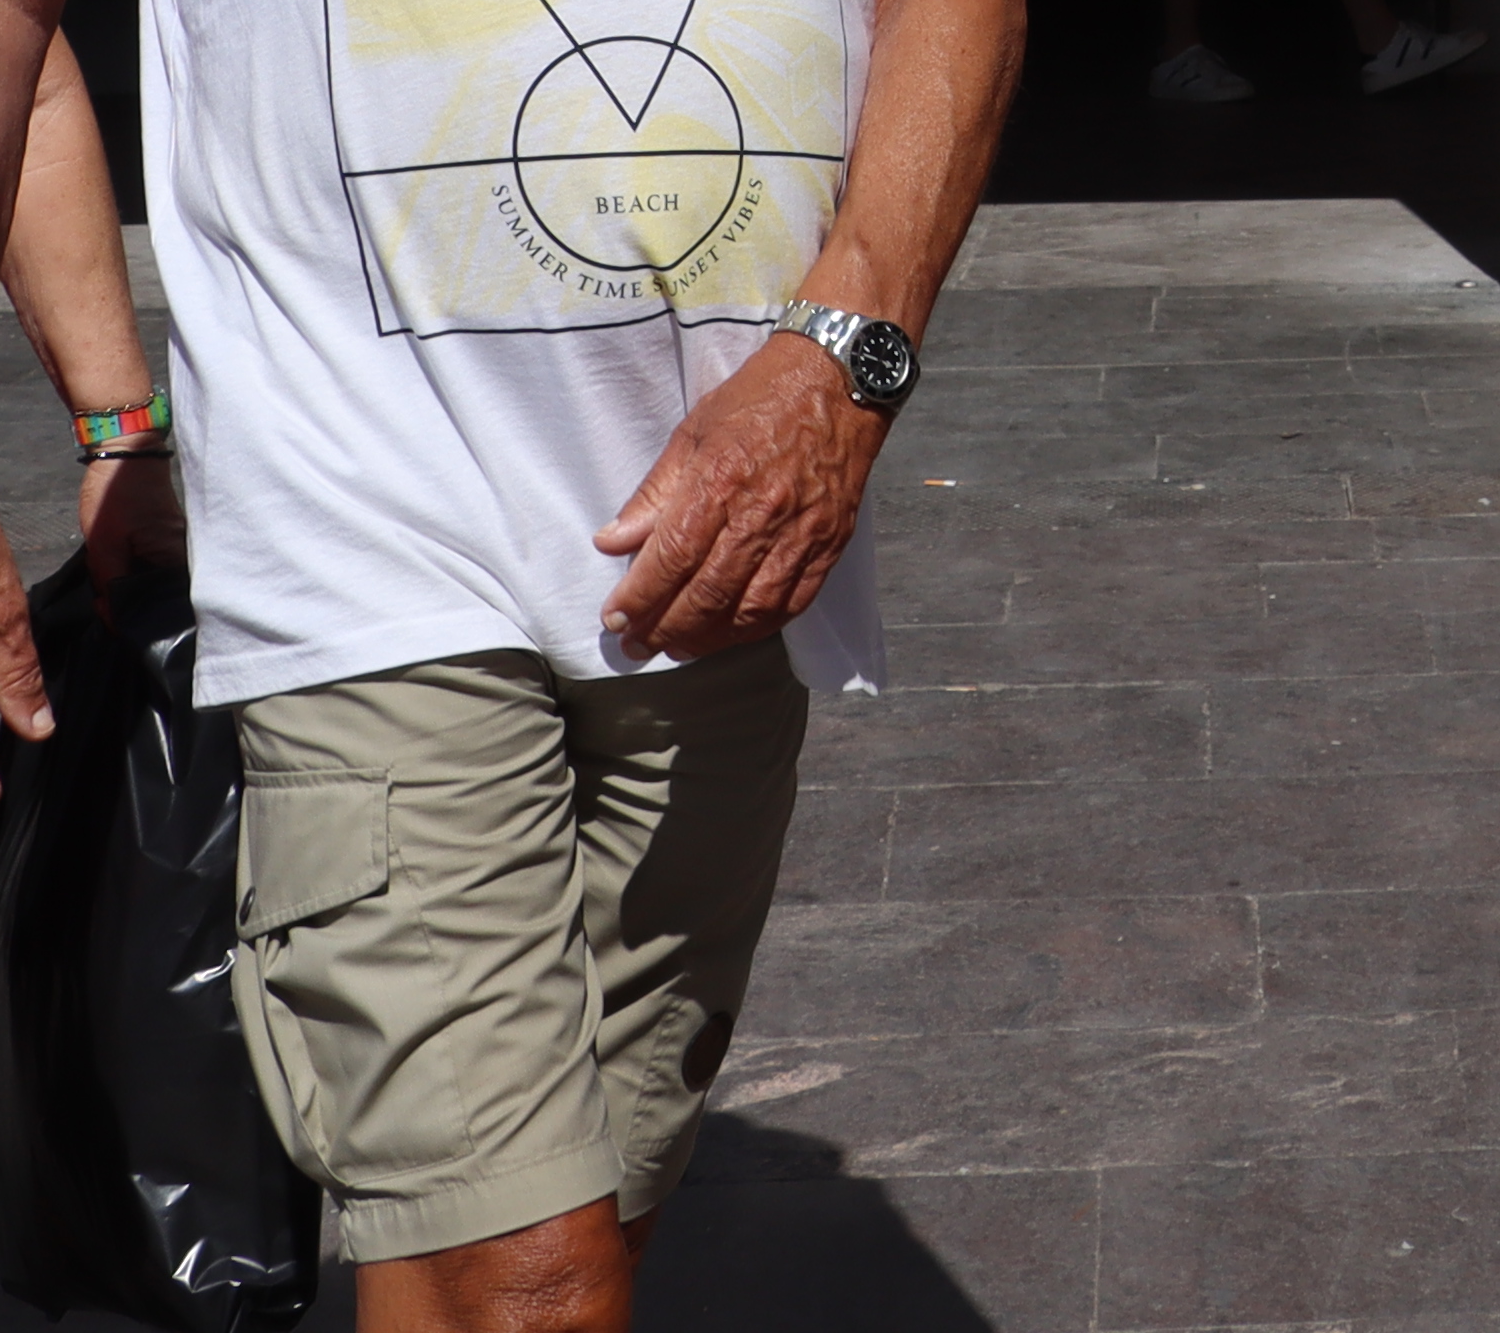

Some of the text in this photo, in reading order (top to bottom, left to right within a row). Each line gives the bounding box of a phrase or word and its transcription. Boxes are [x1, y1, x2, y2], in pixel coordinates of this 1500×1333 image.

[491, 178, 764, 299] SUMMER TIME SUNSET VIBES
[595, 194, 680, 215] BEACH
